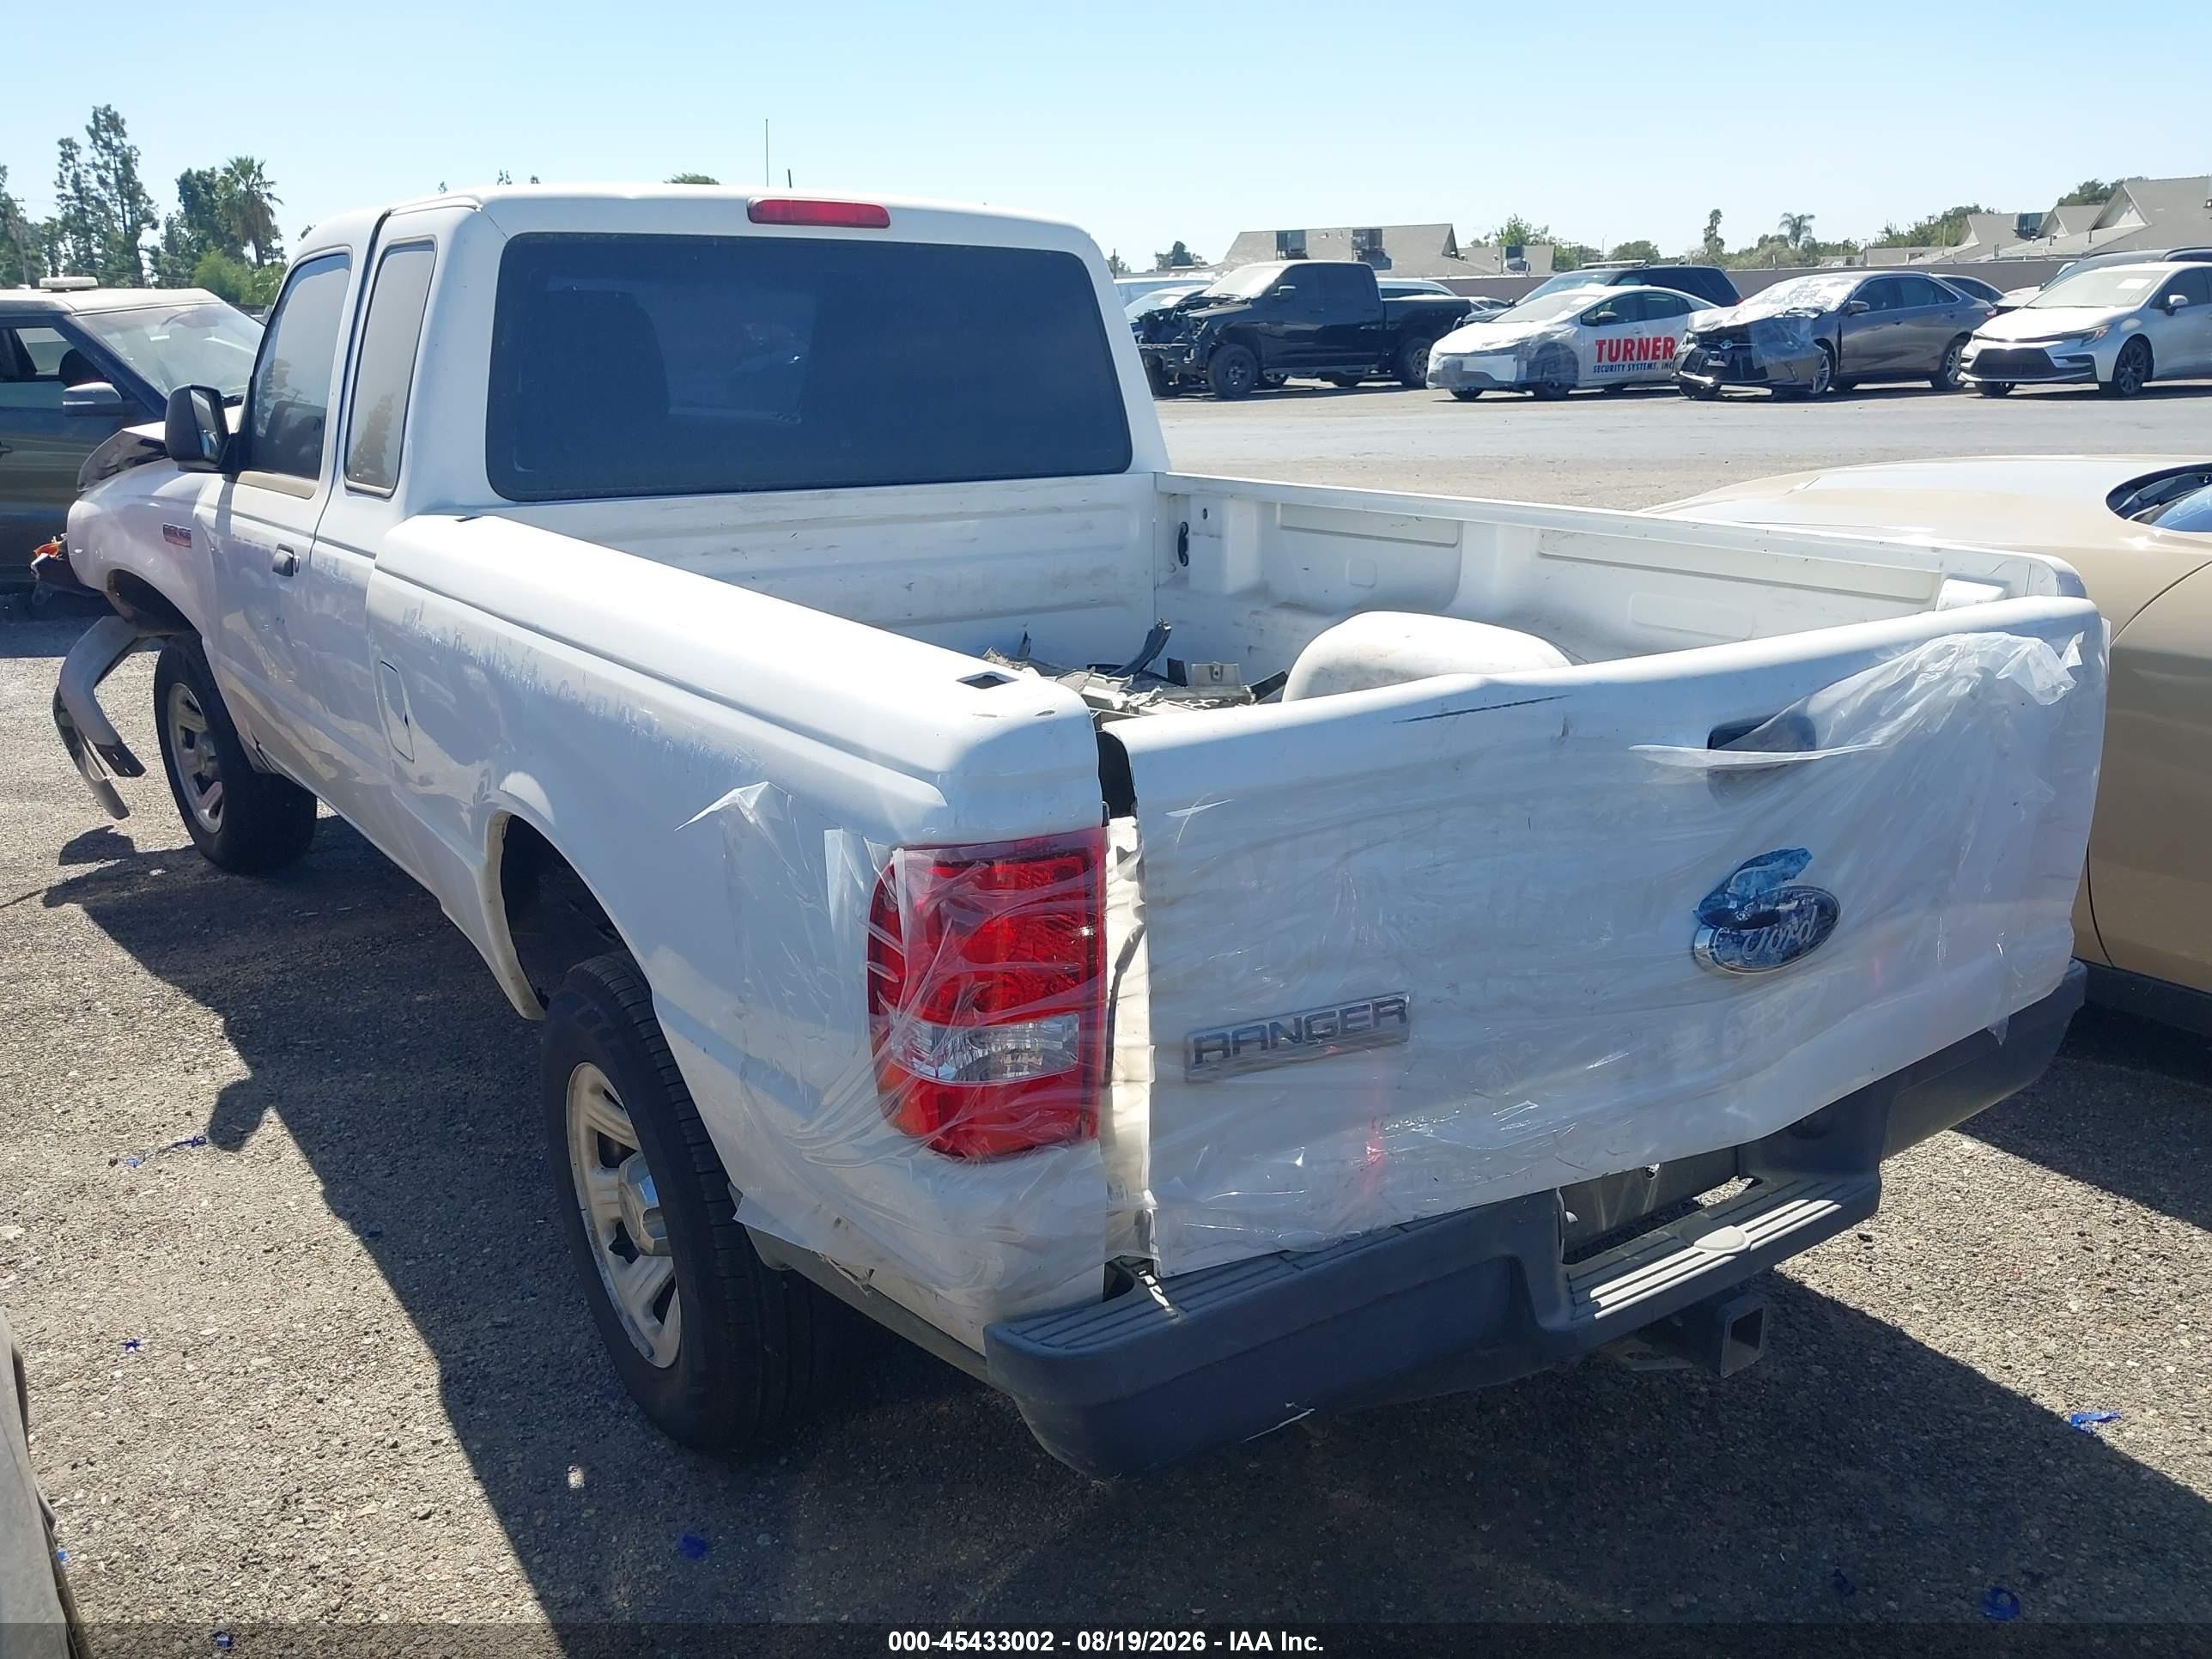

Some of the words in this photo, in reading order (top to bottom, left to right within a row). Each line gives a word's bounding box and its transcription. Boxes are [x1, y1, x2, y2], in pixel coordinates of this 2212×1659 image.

[1594, 363, 1626, 373] SECURITY
[1627, 362, 1659, 372] SYSTEMS,
[1595, 337, 1675, 363] TURNER
[1741, 904, 1818, 960] Ford
[1193, 998, 1407, 1065] RANGER
